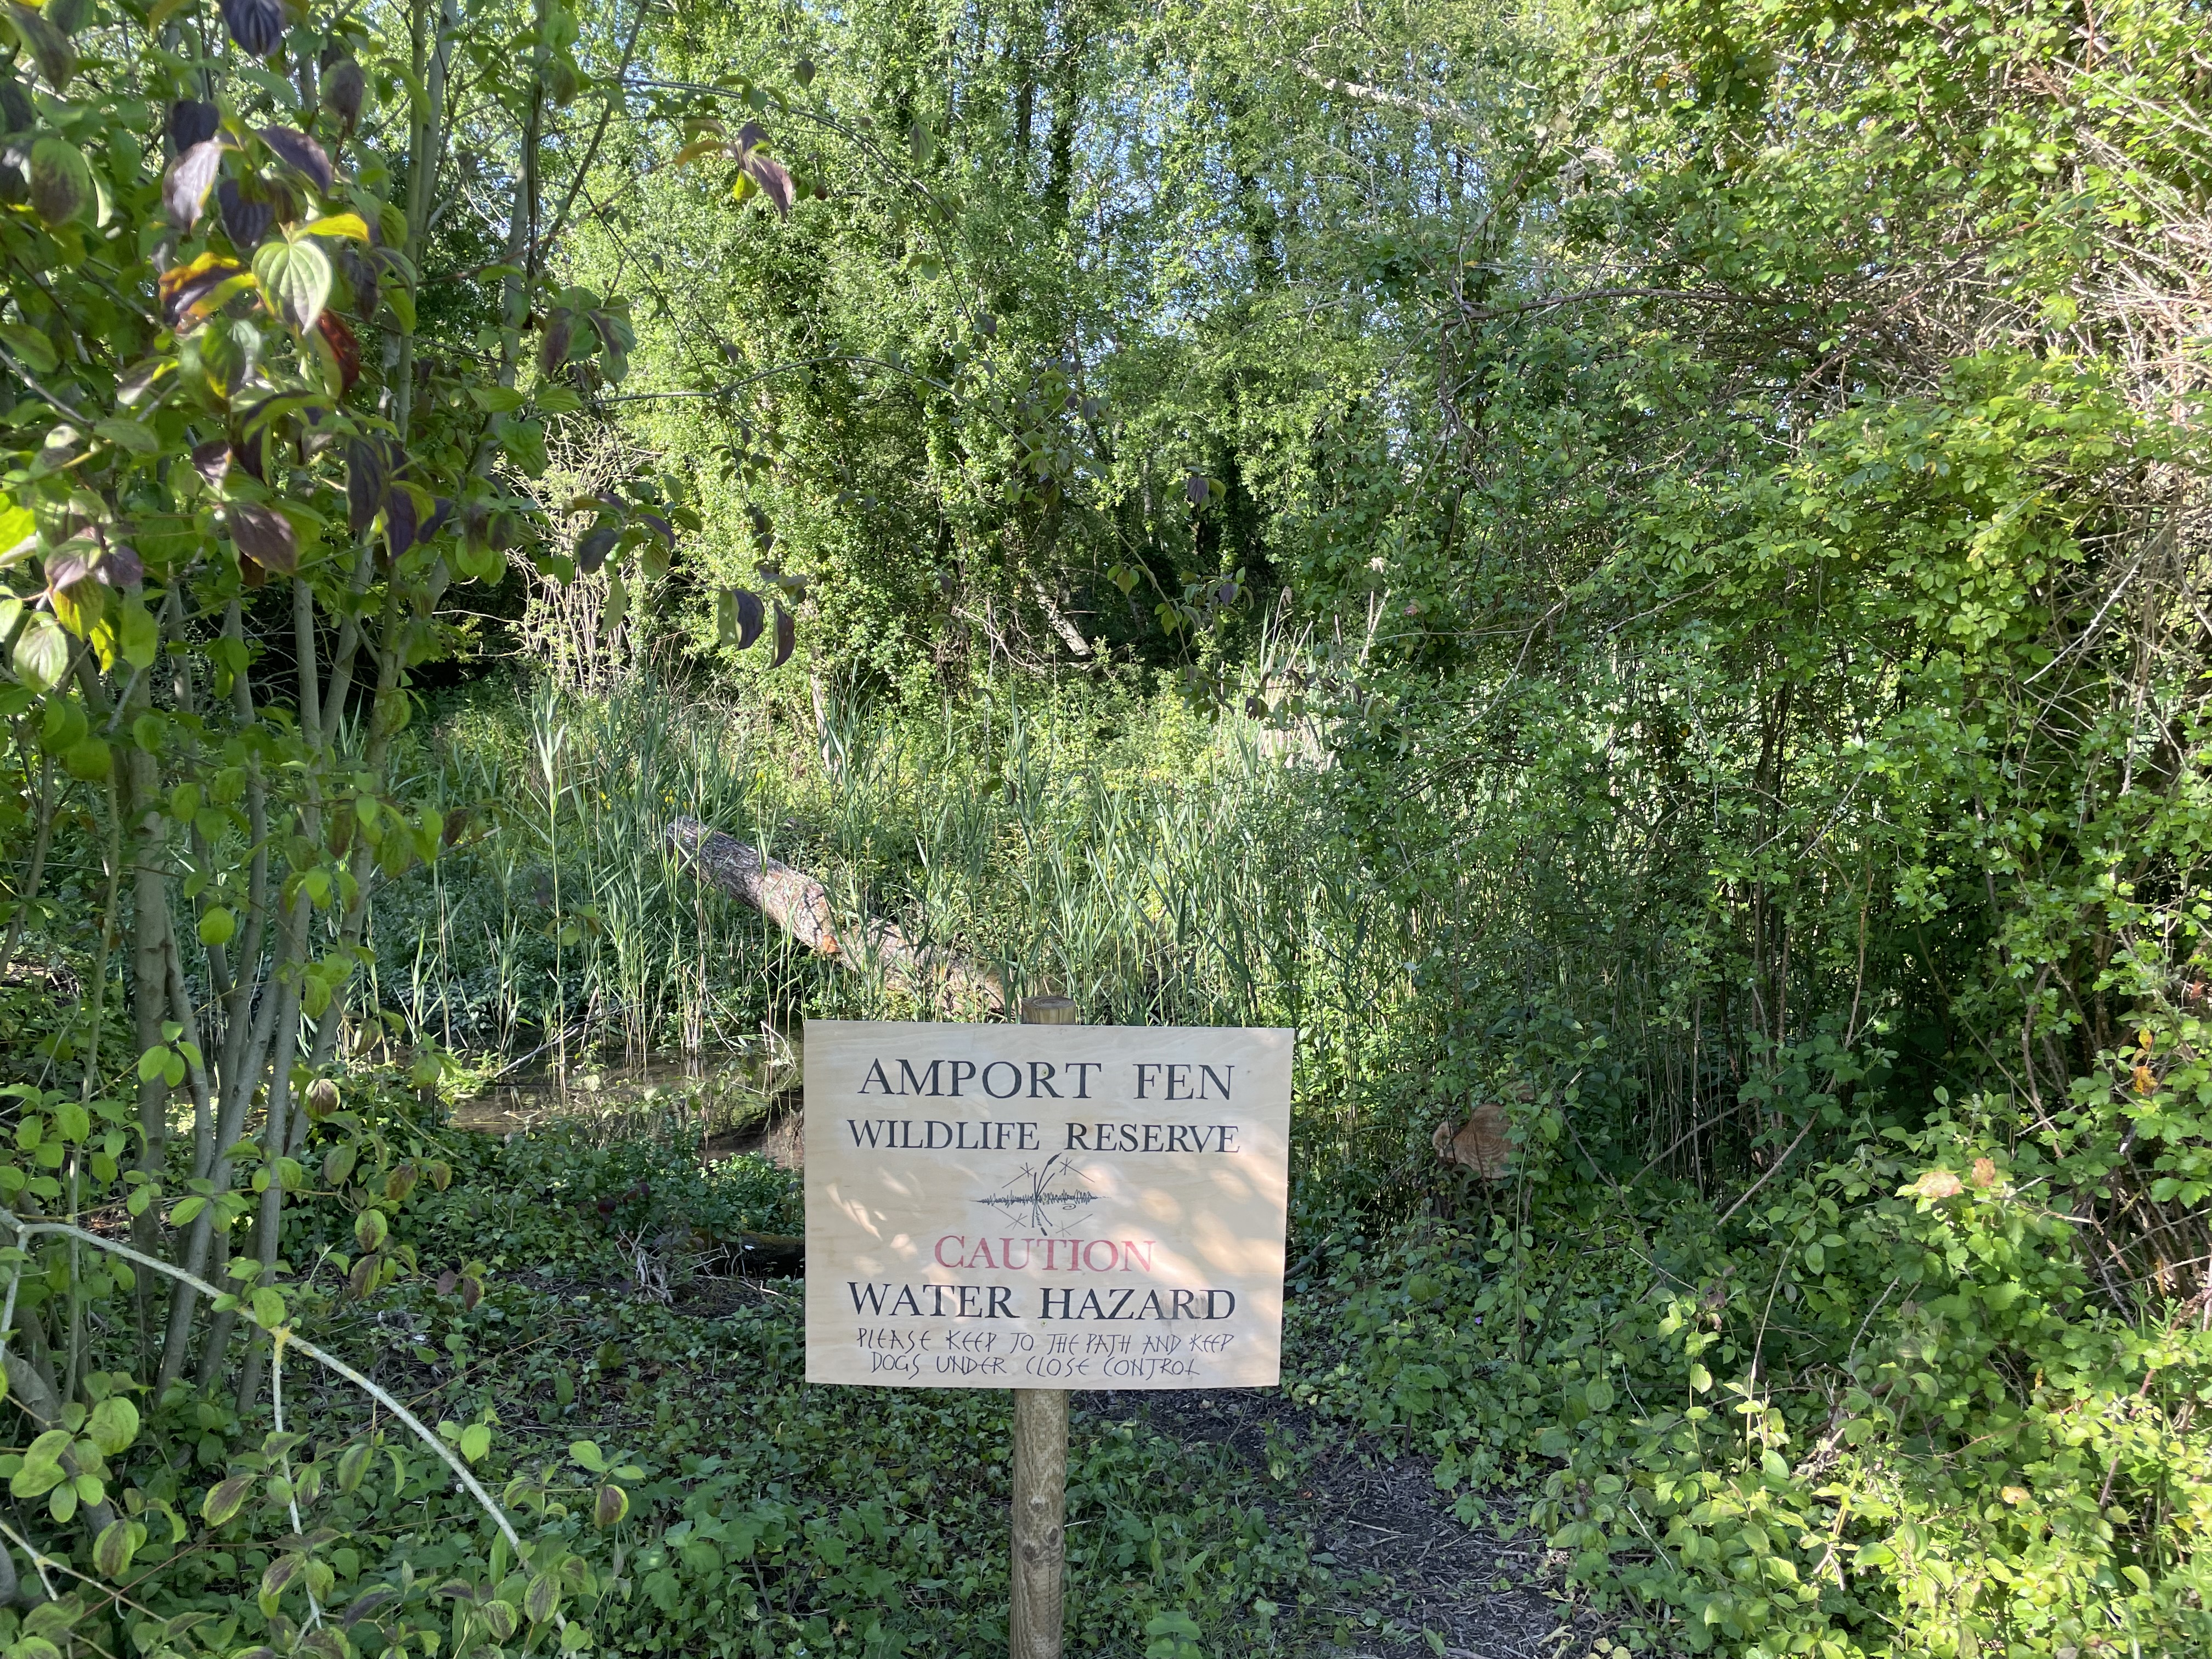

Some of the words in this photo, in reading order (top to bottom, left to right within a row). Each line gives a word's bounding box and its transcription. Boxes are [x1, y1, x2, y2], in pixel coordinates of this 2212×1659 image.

[857, 1058, 1101, 1098] AMPORT
[1133, 1063, 1235, 1100] FEN
[847, 1119, 1040, 1151] WILDLIFE
[1064, 1122, 1240, 1153] RESERVE
[934, 1235, 1156, 1272] CAUTION
[847, 1282, 1020, 1319] WATER
[1038, 1288, 1235, 1321] HAZARD
[857, 1328, 932, 1353] PLEASE
[945, 1330, 997, 1352] KEEP
[1009, 1332, 1034, 1354] TO
[1047, 1333, 1079, 1355] THE
[1086, 1333, 1131, 1357] PATH
[1143, 1334, 1181, 1356] AND
[1190, 1333, 1234, 1354] KEEP
[871, 1353, 919, 1379] DOGS
[936, 1356, 1007, 1375] UNDER
[1026, 1356, 1090, 1377] CLOSE
[1104, 1357, 1200, 1380] CONTROL
